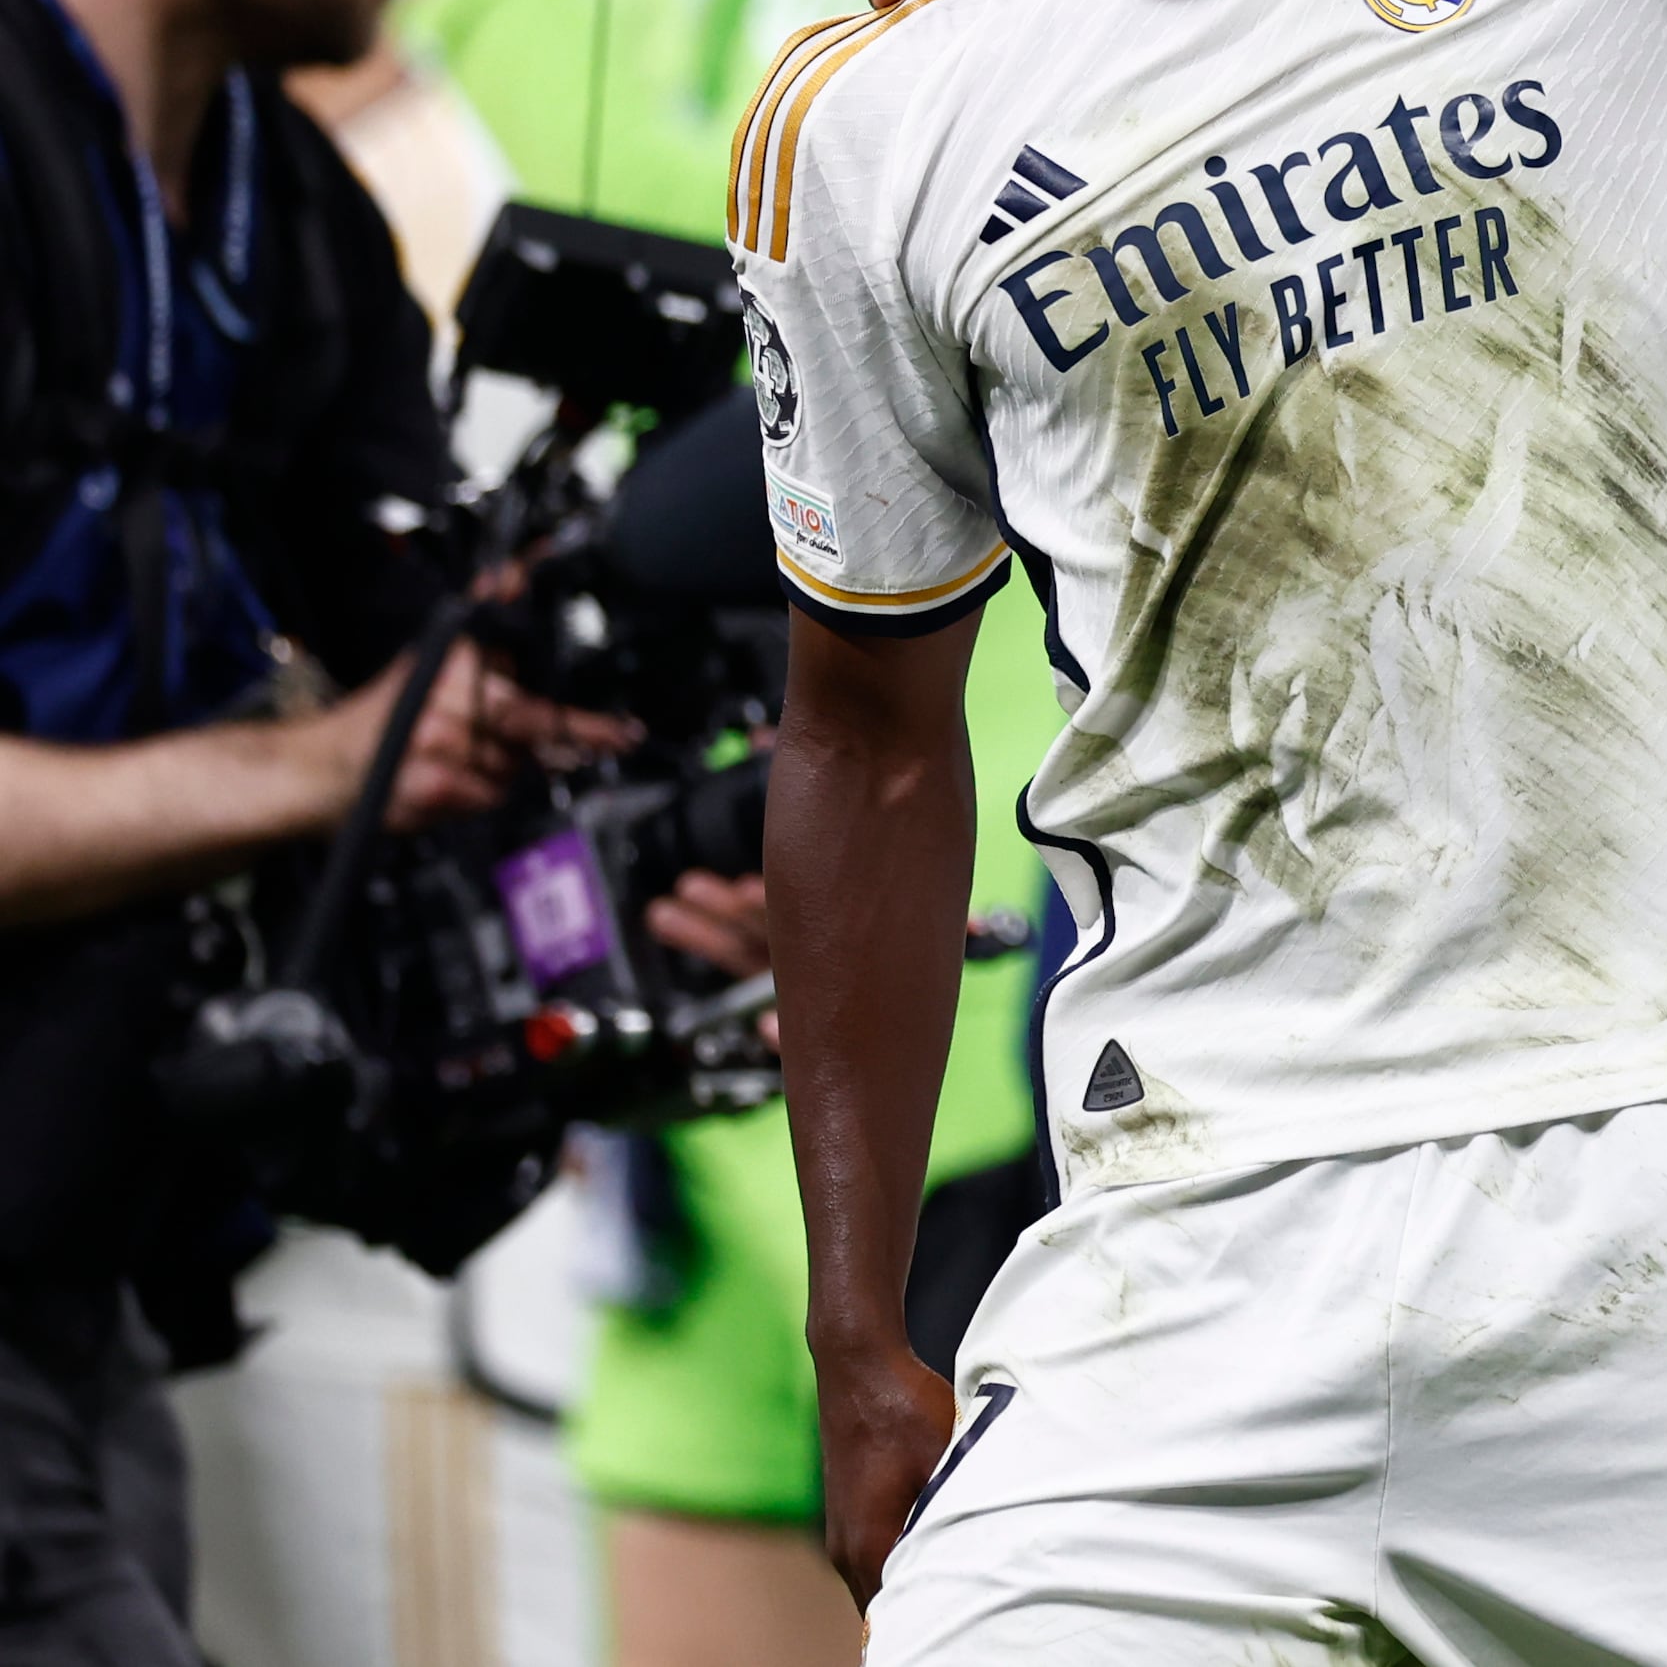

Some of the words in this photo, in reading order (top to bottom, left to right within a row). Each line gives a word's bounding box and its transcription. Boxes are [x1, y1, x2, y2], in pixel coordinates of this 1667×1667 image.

[997, 79, 1563, 374] Emirates
[1140, 301, 1251, 440] FLY
[1269, 206, 1519, 369] BETTER
[890, 1382, 1019, 1551] 7
